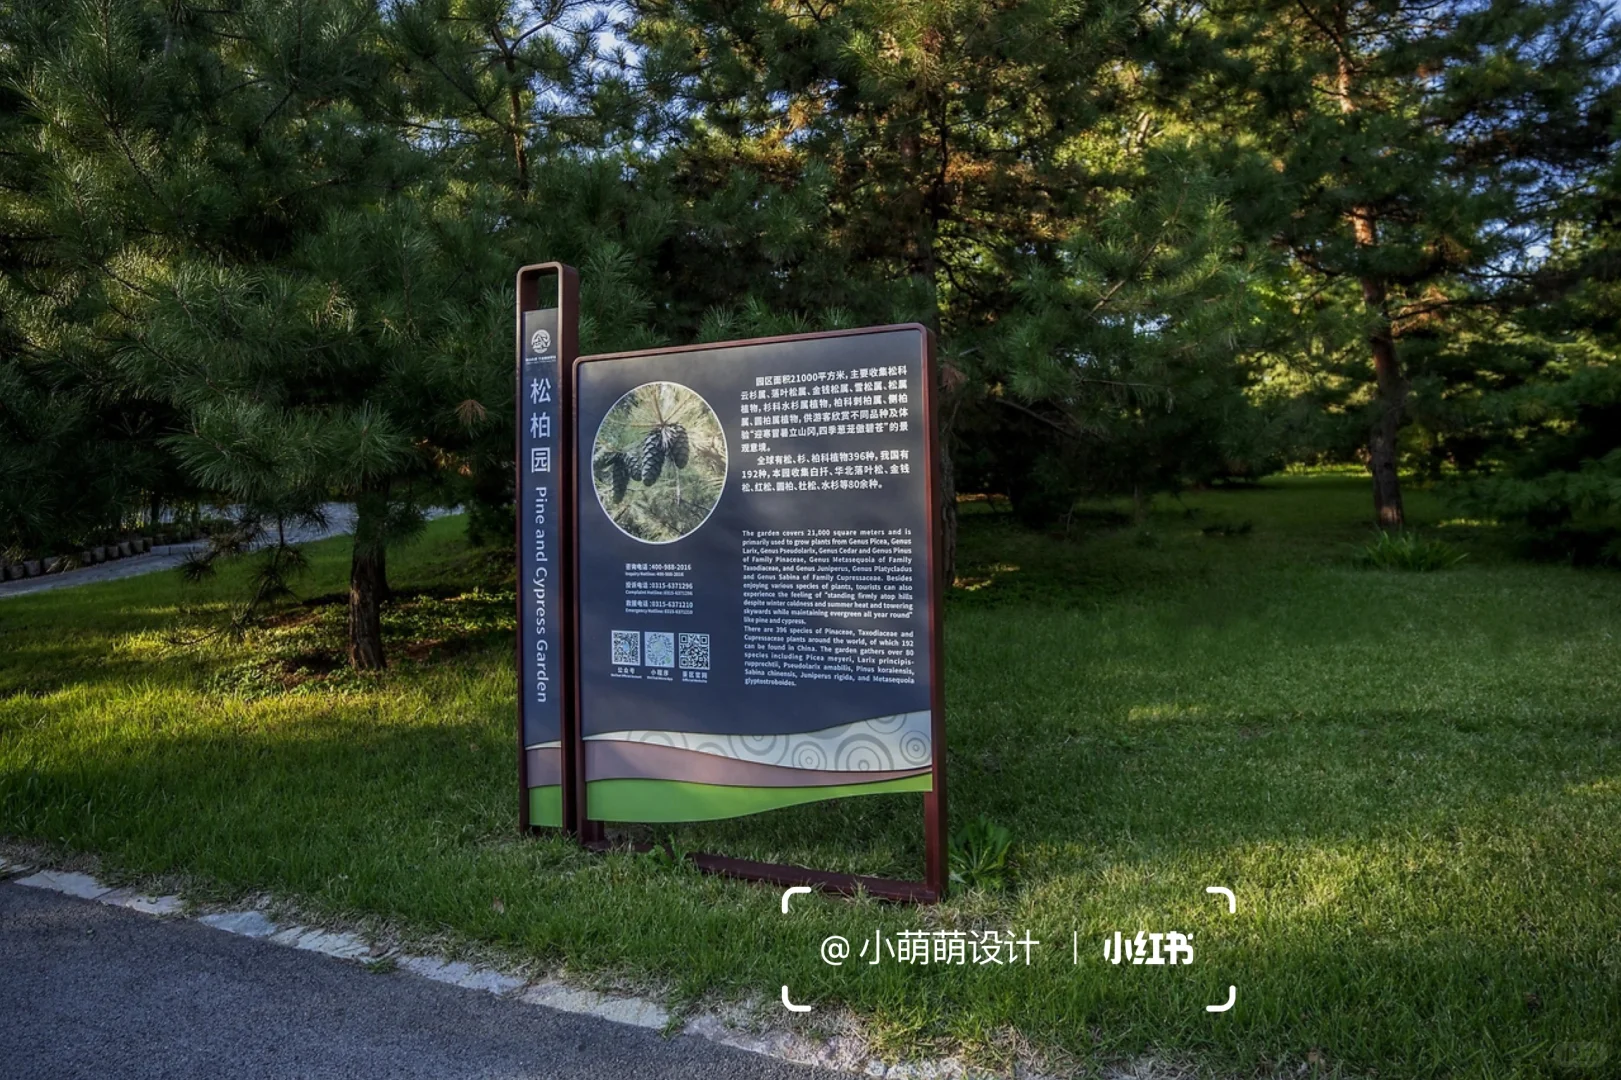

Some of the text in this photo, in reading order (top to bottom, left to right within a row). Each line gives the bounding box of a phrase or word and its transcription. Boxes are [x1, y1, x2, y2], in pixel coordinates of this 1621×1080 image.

[530, 378, 551, 473] 松柏园
[533, 487, 549, 702] Pine and Cypress Garden
